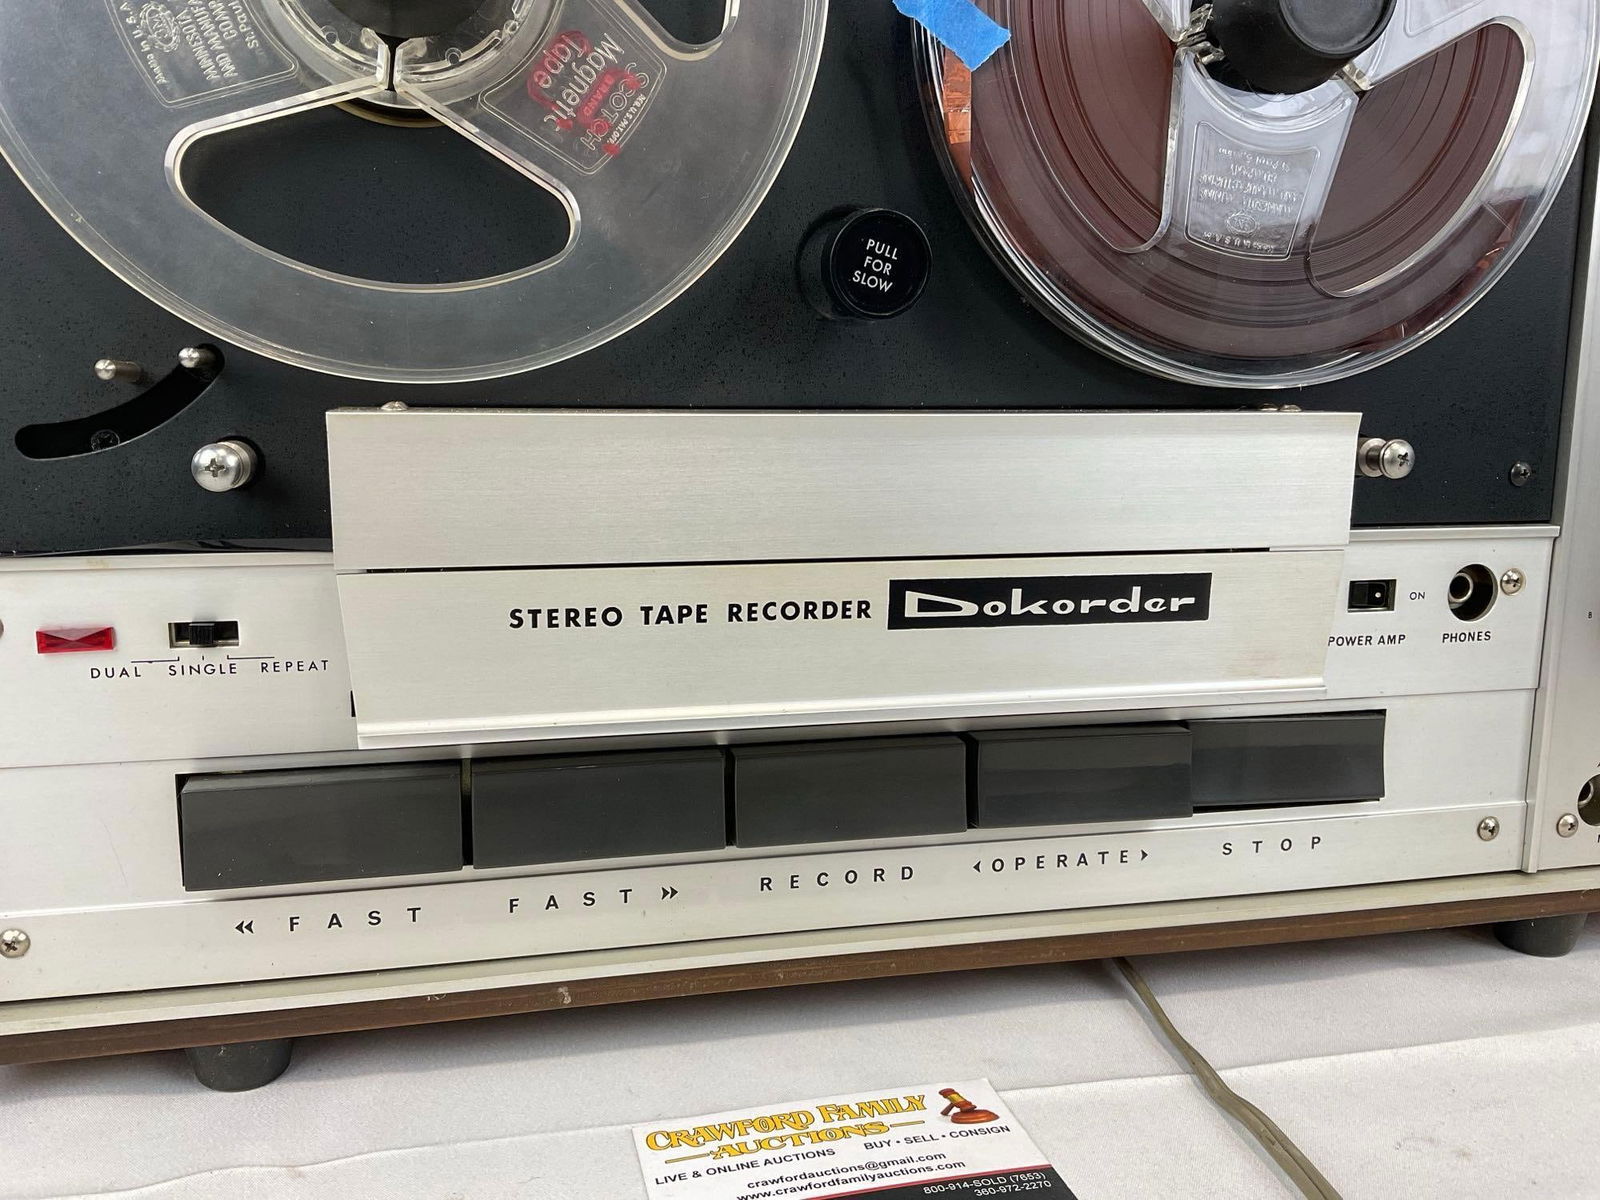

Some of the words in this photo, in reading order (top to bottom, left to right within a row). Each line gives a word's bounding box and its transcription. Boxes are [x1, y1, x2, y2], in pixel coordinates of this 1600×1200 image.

[175, 9, 221, 80] MINNESOTA
[533, 34, 584, 89] Tape
[543, 32, 625, 132] Magnetic
[580, 62, 650, 151] SCOTCH
[866, 238, 898, 260] PULL
[863, 255, 892, 276] FOR
[852, 270, 893, 293] SLOW
[904, 586, 1196, 618] Dokorder
[1409, 591, 1426, 601] ON
[508, 607, 624, 629] STEREO
[640, 604, 709, 626] TAPE
[727, 600, 872, 623] RECORDER
[1328, 635, 1373, 647] POWER
[1377, 634, 1406, 645] AMP
[1442, 631, 1492, 643] PHONES
[90, 666, 142, 679] DUAL
[168, 663, 238, 676] SINGLE
[261, 660, 329, 673] REPEAT
[1222, 836, 1322, 856] STOP
[991, 849, 1130, 873] OPERATE
[760, 865, 915, 891] RECORD
[508, 888, 633, 914] FAST
[289, 906, 422, 932] FAST
[645, 1110, 815, 1151] CRAWFORD
[816, 1094, 928, 1123] FAMILY
[709, 1120, 890, 1160] AUCTIONS
[863, 1139, 892, 1150] BUY
[904, 1133, 939, 1145] SELL
[949, 1125, 1011, 1139] CONSIGN
[655, 1172, 688, 1185] LIVE
[692, 1170, 702, 1179] &
[706, 1160, 760, 1176] ONLINE
[763, 1148, 836, 1167] AUCTIONS
[747, 1151, 947, 1189] crawfordauctions@gmail.com
[736, 1160, 966, 1200] www.crawfordfamilyauctions.com
[923, 1176, 1007, 1195] 800-914-SOLD
[1009, 1172, 1047, 1184] (7653)
[974, 1180, 1052, 1197] 360-972-2270
